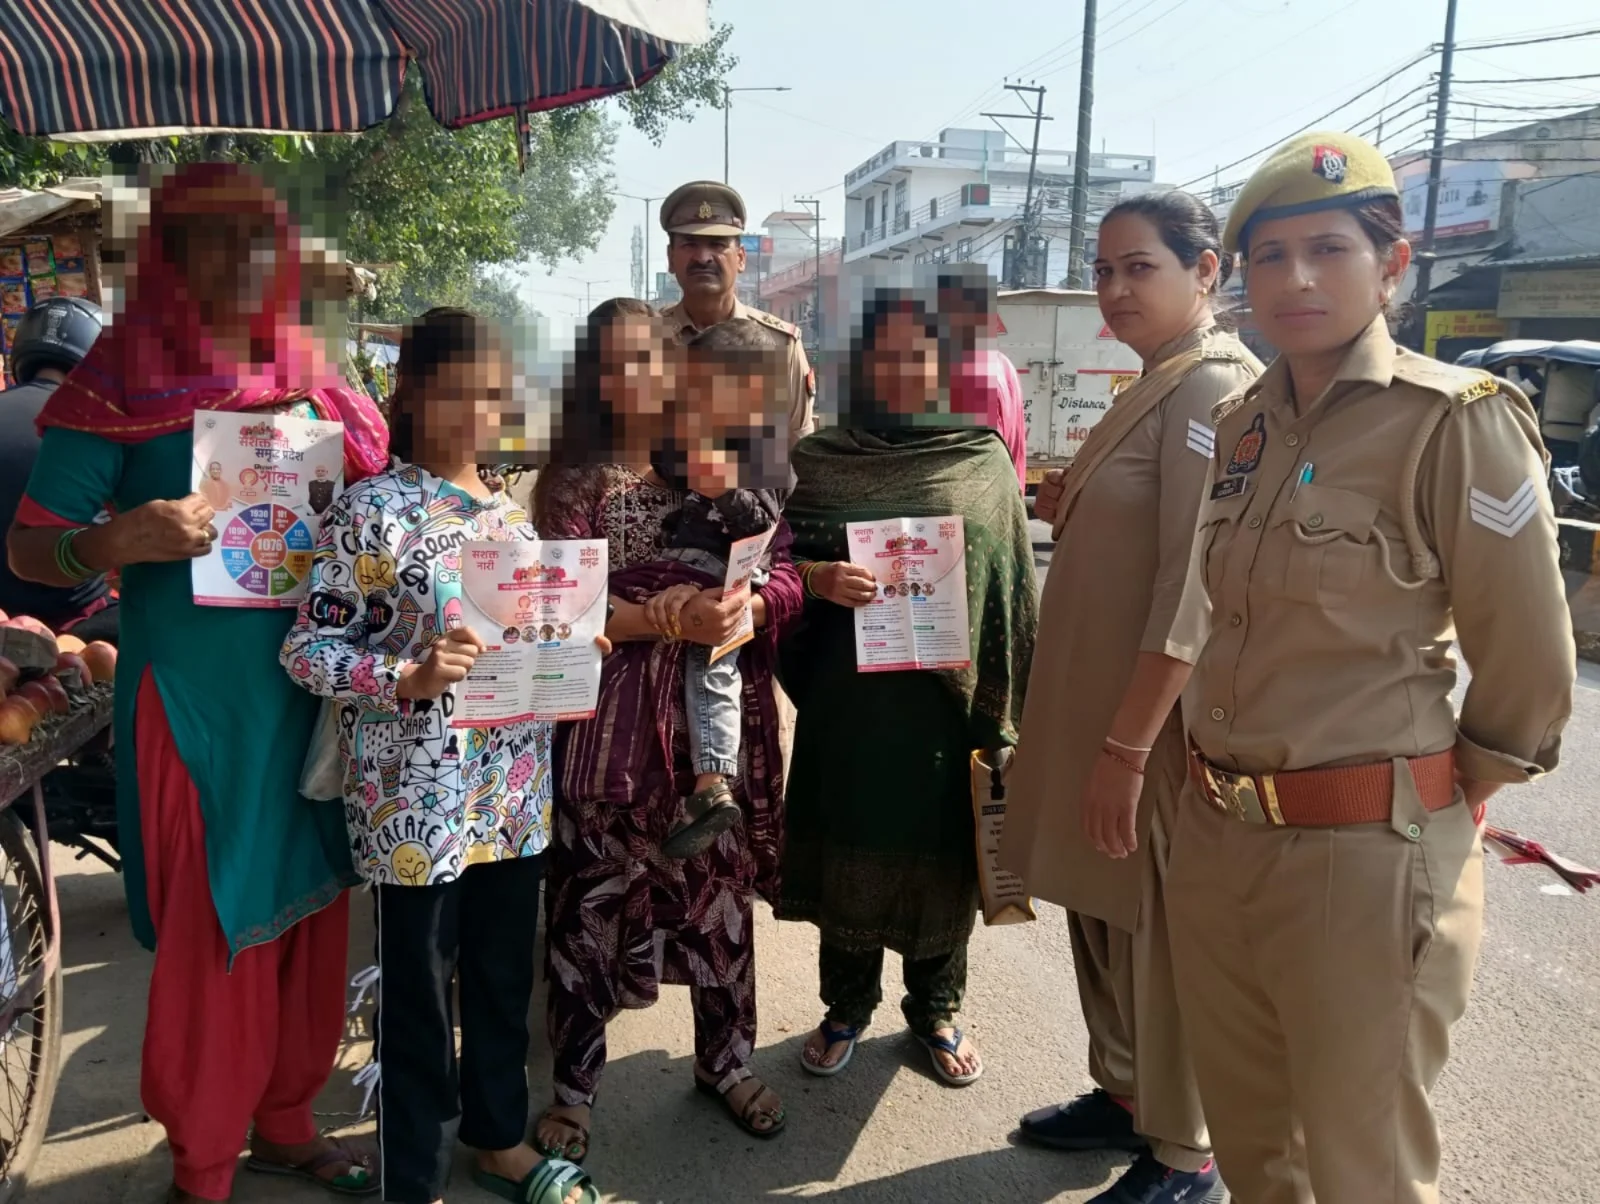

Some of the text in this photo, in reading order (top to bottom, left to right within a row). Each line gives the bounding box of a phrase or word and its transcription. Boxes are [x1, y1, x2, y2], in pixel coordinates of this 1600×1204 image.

[256, 538, 283, 551] 1076
[472, 550, 499, 559] सशक्त
[579, 546, 599, 557] प्रदेश
[476, 560, 494, 571] नारी
[579, 557, 599, 569] समृद्ध
